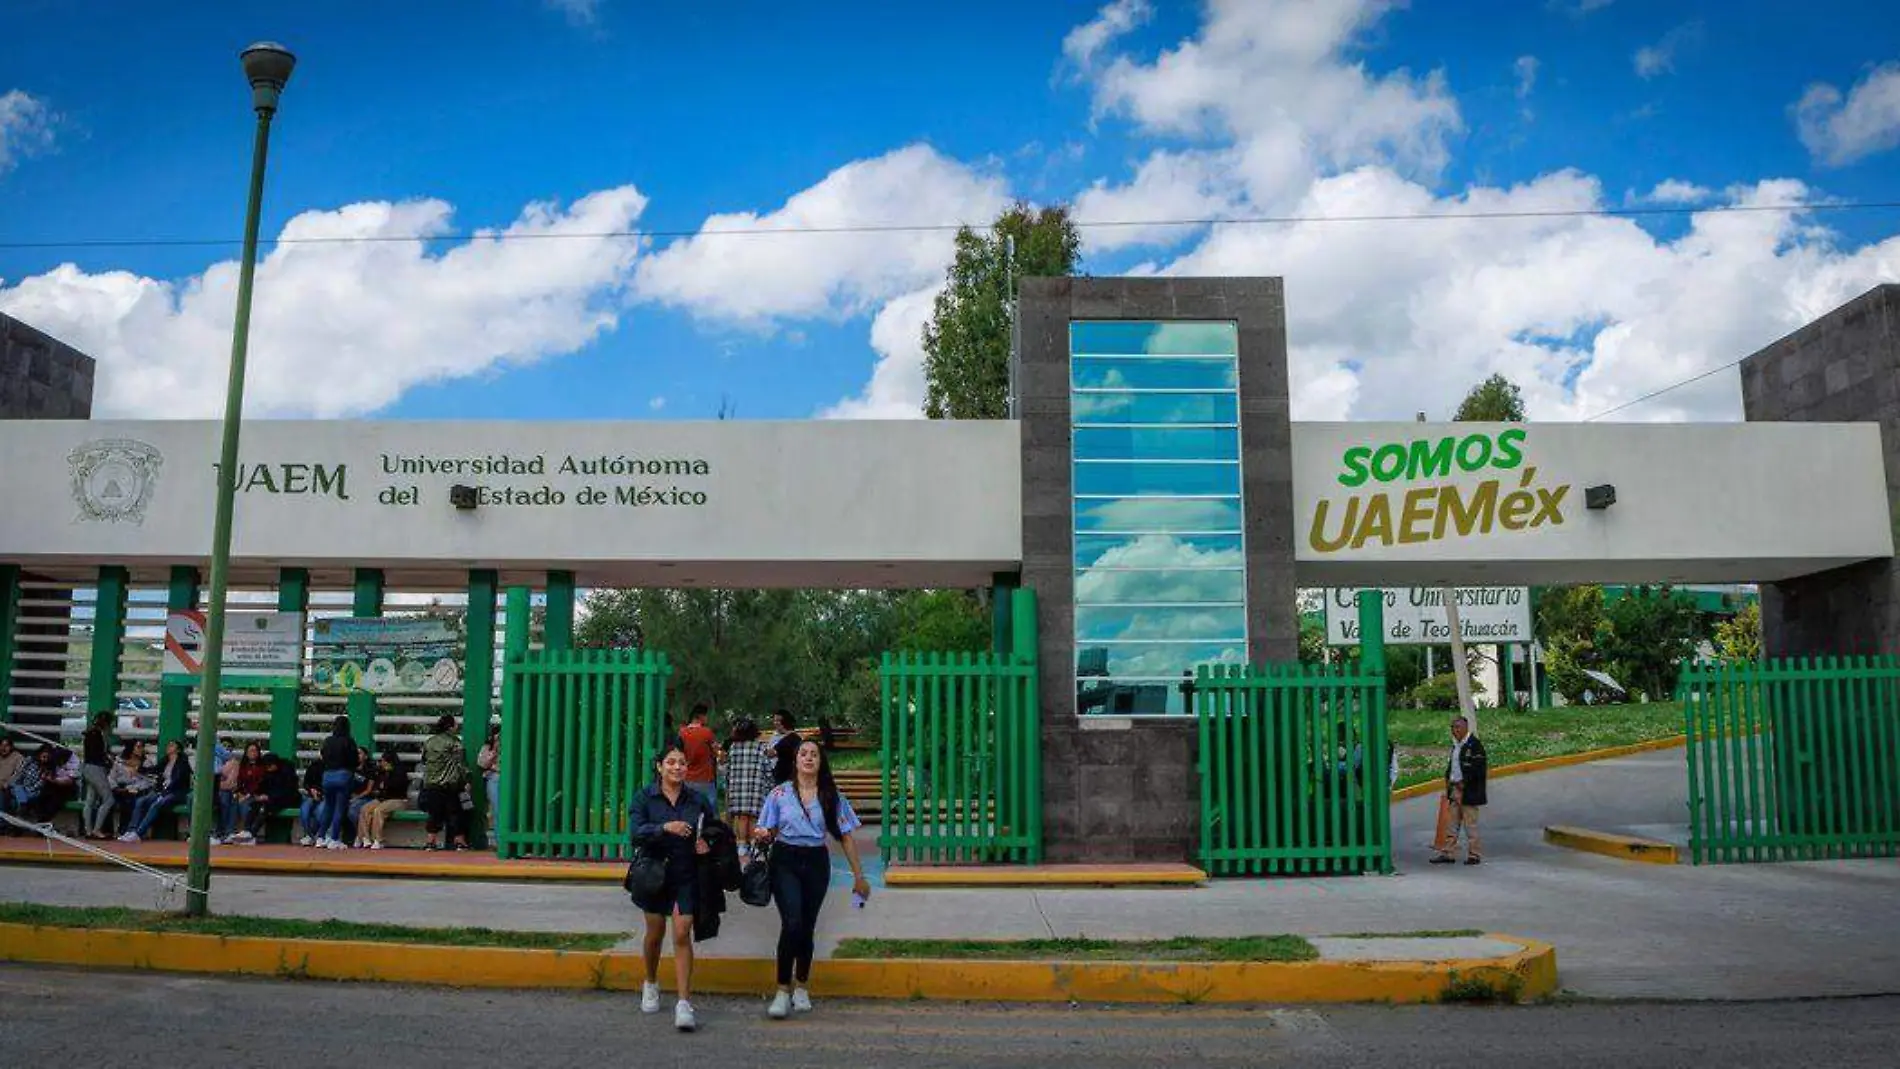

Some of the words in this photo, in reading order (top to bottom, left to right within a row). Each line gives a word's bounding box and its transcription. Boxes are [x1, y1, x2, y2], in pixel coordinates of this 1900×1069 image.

[381, 452, 545, 475] Universidad
[558, 454, 710, 475] Autónoma
[1338, 428, 1527, 487] SOMOS
[378, 486, 419, 506] del
[478, 485, 565, 506] Estado
[576, 486, 608, 506] de
[615, 485, 707, 508] México
[1309, 466, 1572, 553] UAEMéx
[1391, 620, 1411, 638] de
[1420, 619, 1518, 638] Teoihuacán
